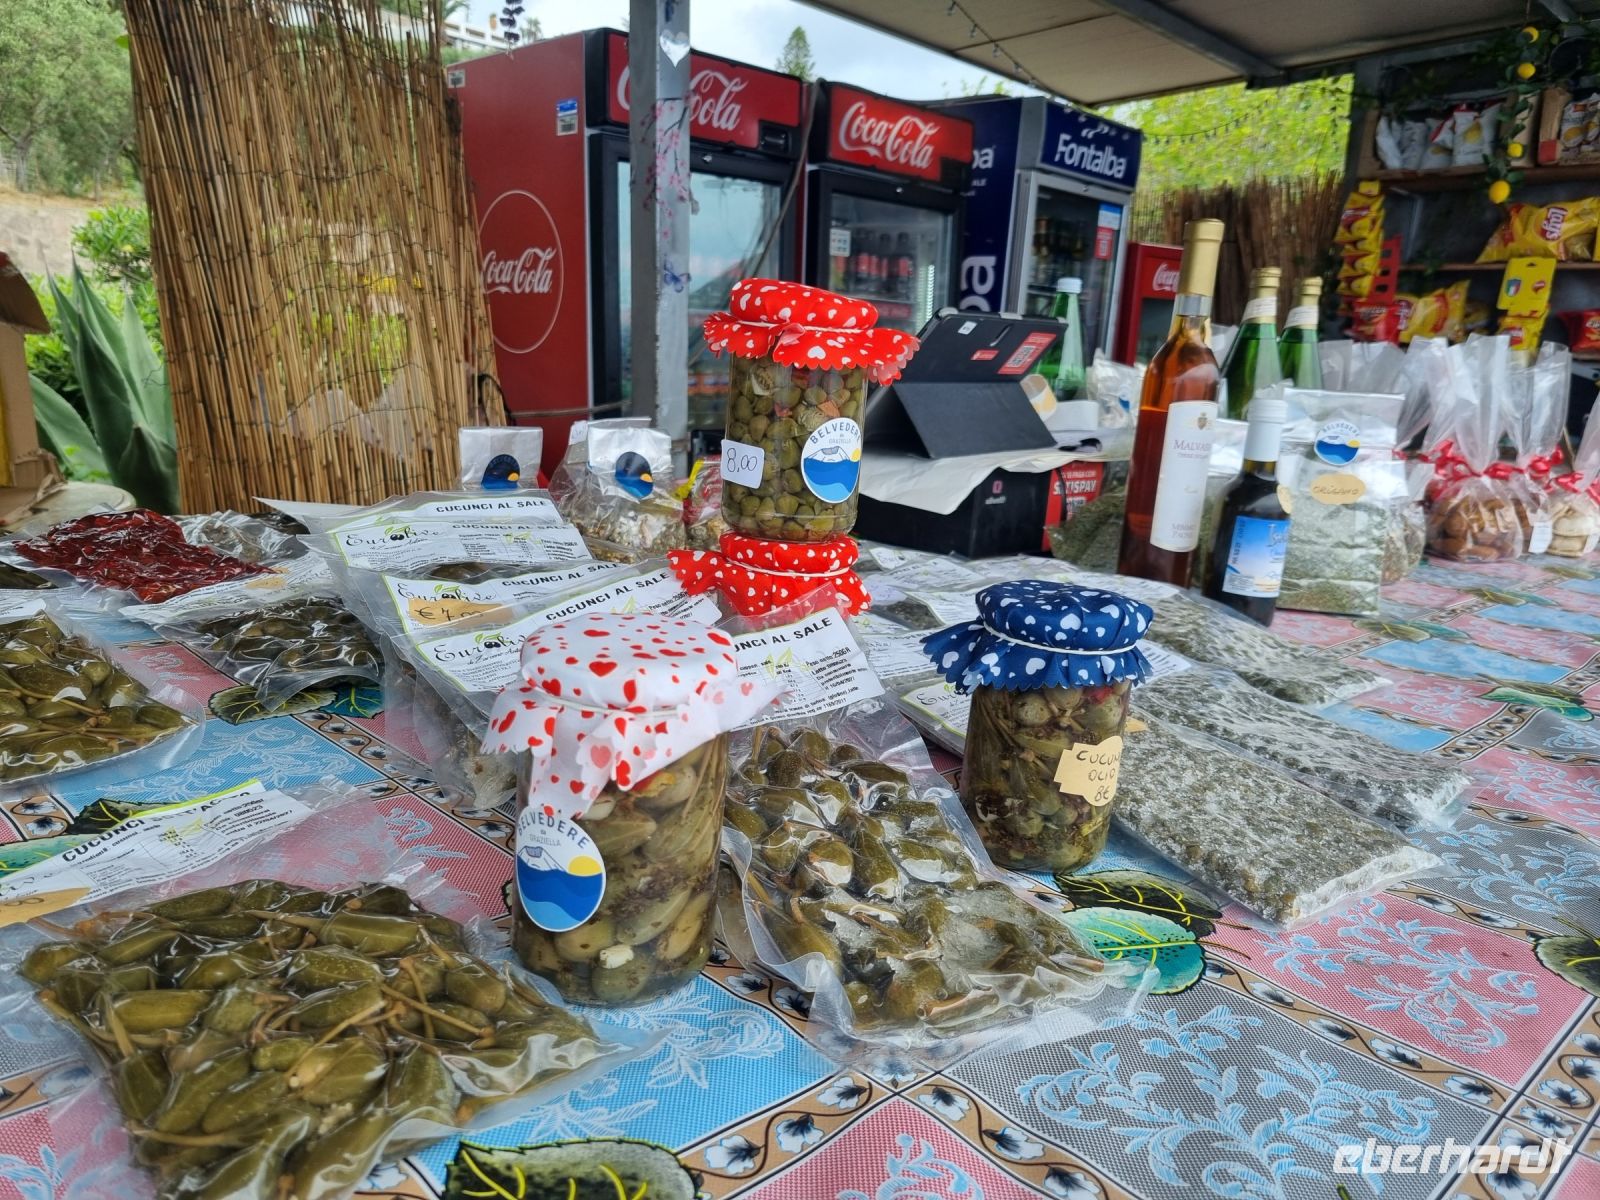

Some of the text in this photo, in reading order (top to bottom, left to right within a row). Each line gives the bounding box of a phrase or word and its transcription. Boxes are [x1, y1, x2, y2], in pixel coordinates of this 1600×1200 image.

[838, 101, 940, 170] Coca-Cola
[1054, 132, 1128, 179] Fontalba
[726, 447, 757, 473] 8,00
[436, 503, 493, 513] CUCUNCI
[517, 500, 547, 508] SALE
[502, 563, 621, 587] CUCUNCI AL SALE
[546, 571, 670, 621] CUCUNCI AL SALE
[772, 634, 790, 645] AL
[795, 617, 832, 639] SALE
[62, 818, 145, 862] CUCUNCI
